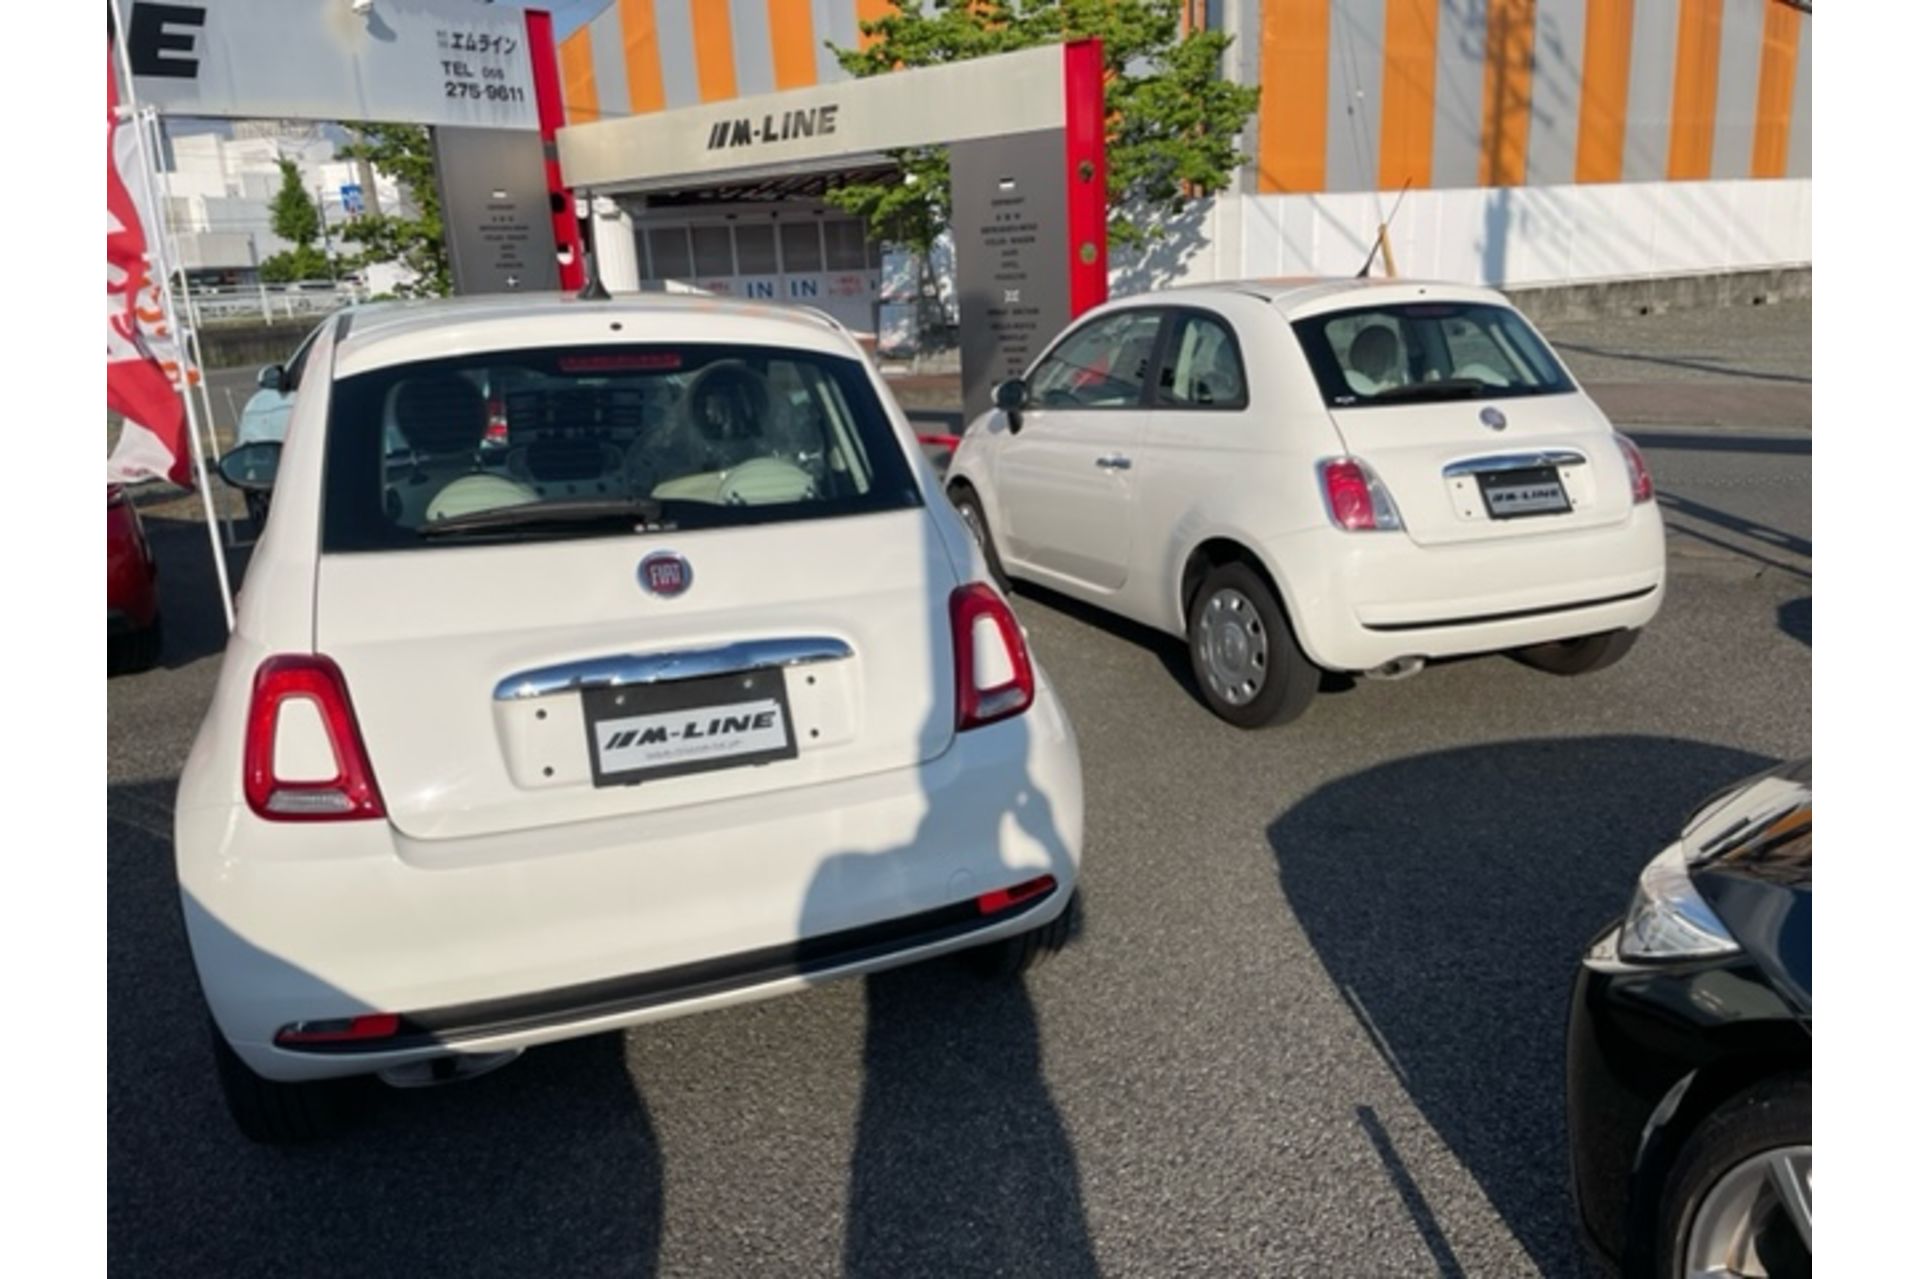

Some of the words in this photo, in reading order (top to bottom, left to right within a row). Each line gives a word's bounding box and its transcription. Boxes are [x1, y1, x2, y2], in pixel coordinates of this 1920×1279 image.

[450, 31, 518, 55] エムライン
[441, 61, 474, 78] TEL
[747, 282, 773, 298] IN
[791, 280, 817, 296] IN
